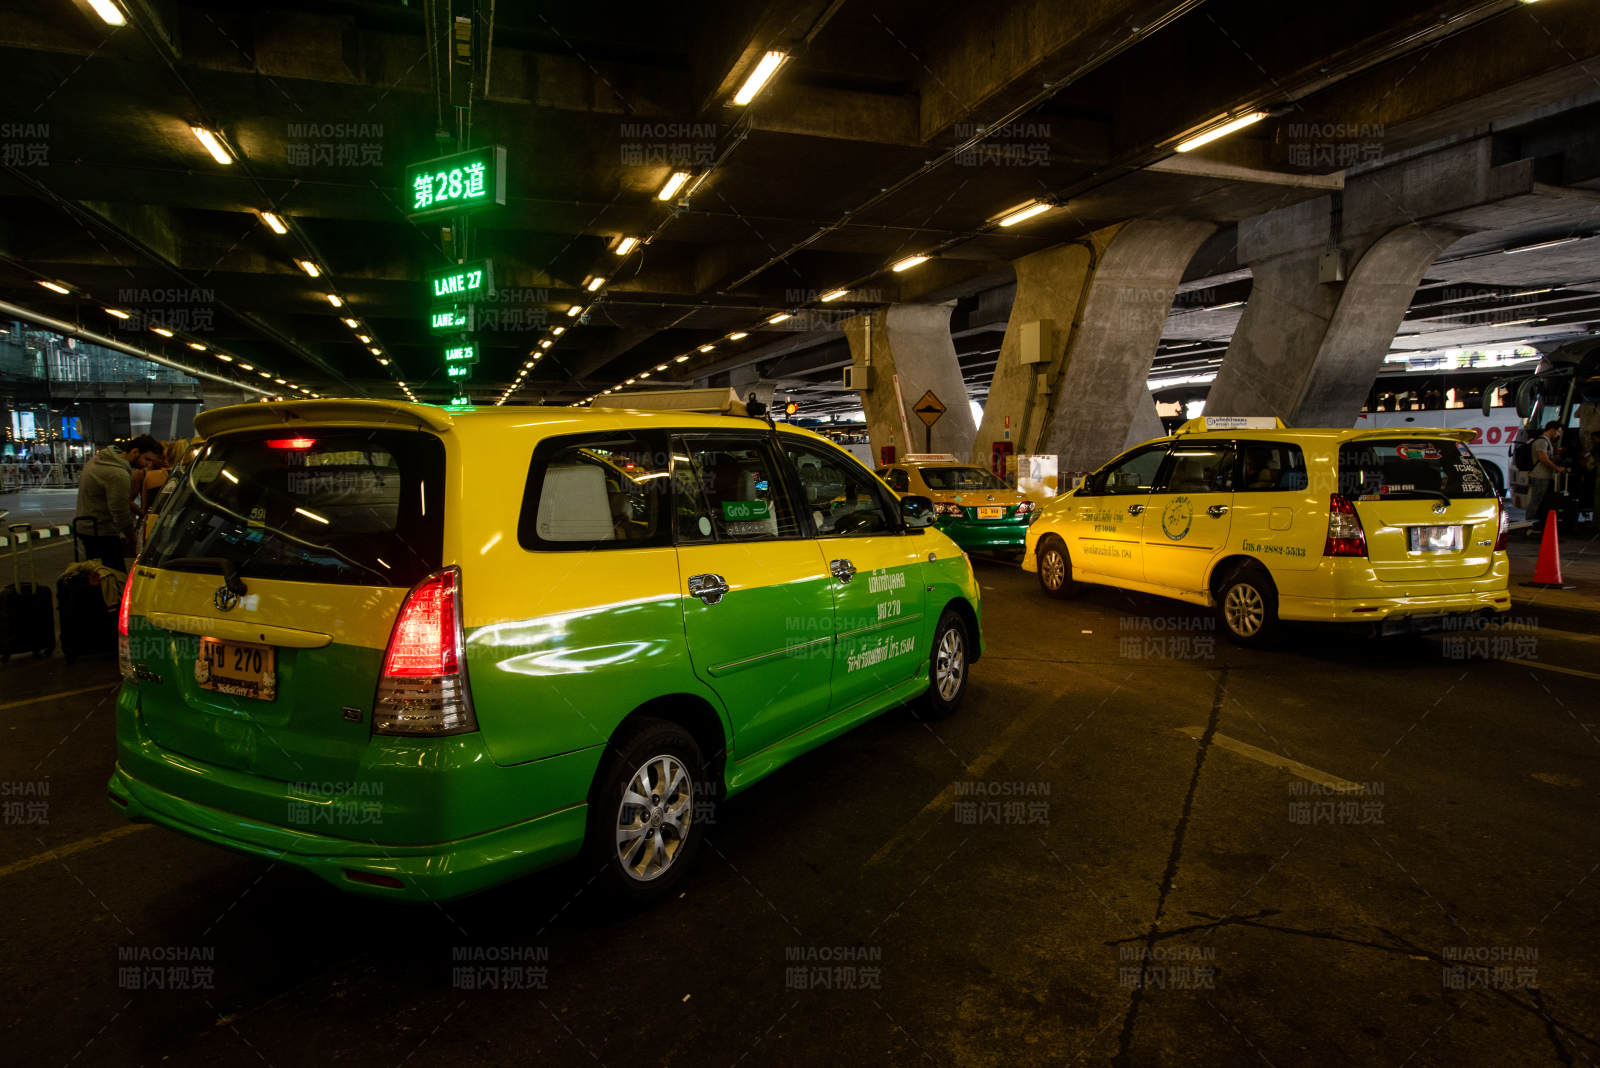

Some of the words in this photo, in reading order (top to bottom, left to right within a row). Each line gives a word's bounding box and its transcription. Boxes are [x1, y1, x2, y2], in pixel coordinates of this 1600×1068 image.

[413, 162, 486, 209] 第28道
[434, 274, 465, 296] LANE
[467, 270, 482, 289] 27
[432, 313, 454, 328] LANE
[446, 348, 463, 360] LANE
[727, 503, 750, 517] Grab
[887, 600, 901, 618] 270
[234, 647, 263, 674] 270
